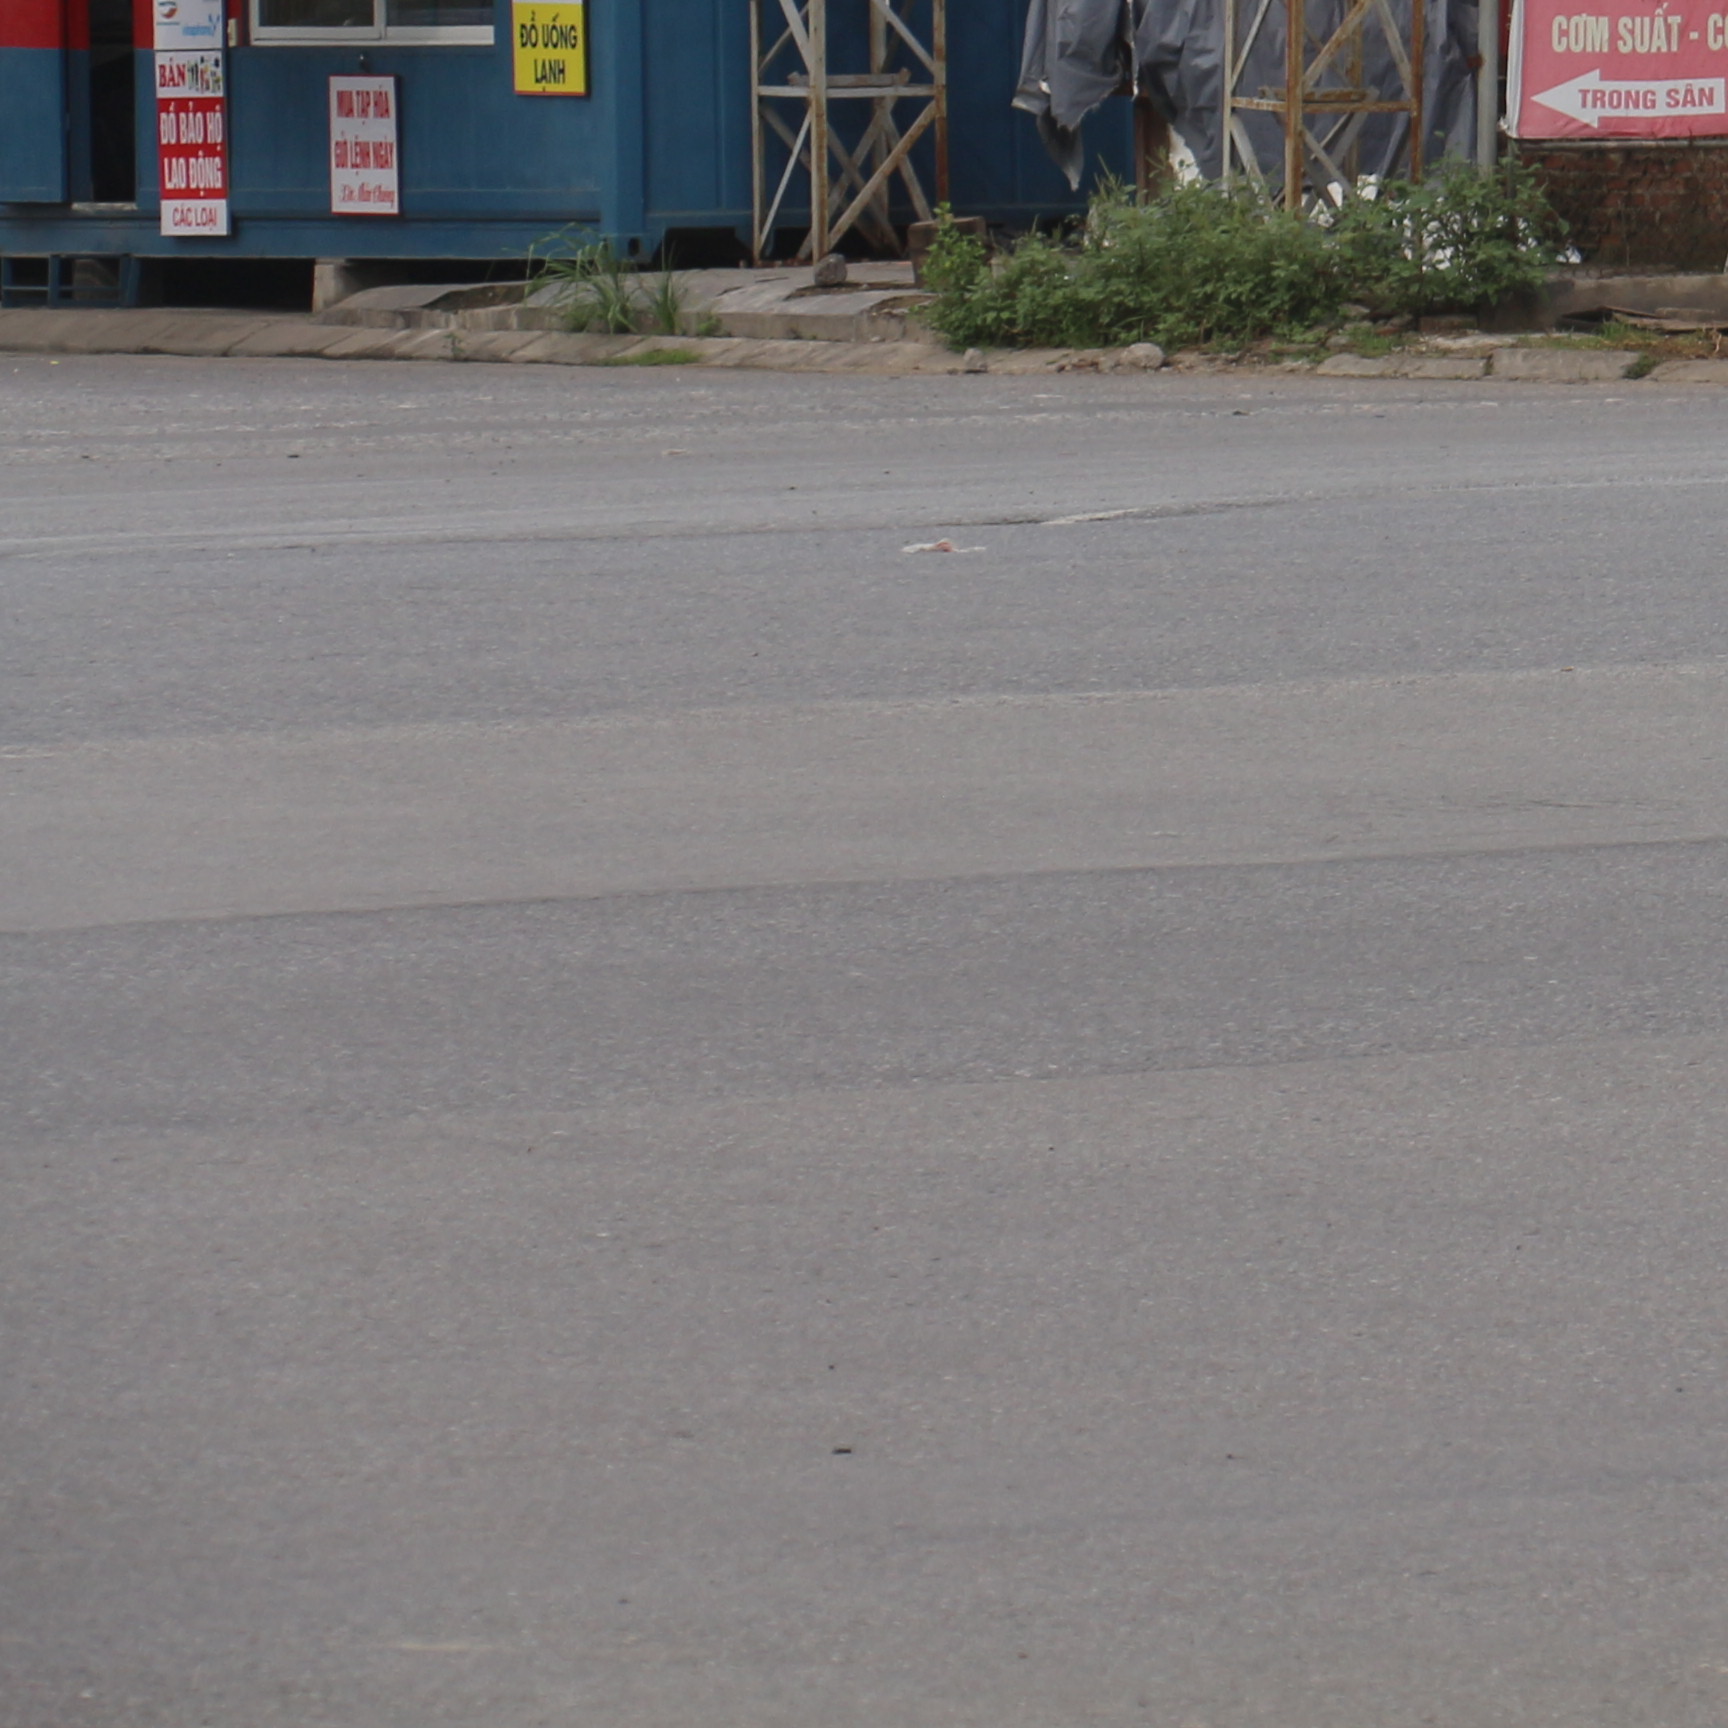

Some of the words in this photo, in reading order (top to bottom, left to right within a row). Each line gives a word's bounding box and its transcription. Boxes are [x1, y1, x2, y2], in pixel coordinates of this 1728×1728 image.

[542, 12, 577, 49] UỐNG
[1552, 13, 1609, 53] CƠM
[1617, 3, 1682, 54] SUẤT
[158, 57, 186, 88] BÁN
[534, 58, 565, 91] LẠNH
[1579, 88, 1657, 110] TRONG
[1665, 84, 1714, 109] SÂN
[179, 101, 204, 144] BẢO
[206, 104, 223, 151] HỘ
[164, 157, 187, 189] LAO
[189, 150, 222, 197] ĐỘNG
[173, 204, 192, 226] CÁC
[195, 207, 217, 230] LOẠI
